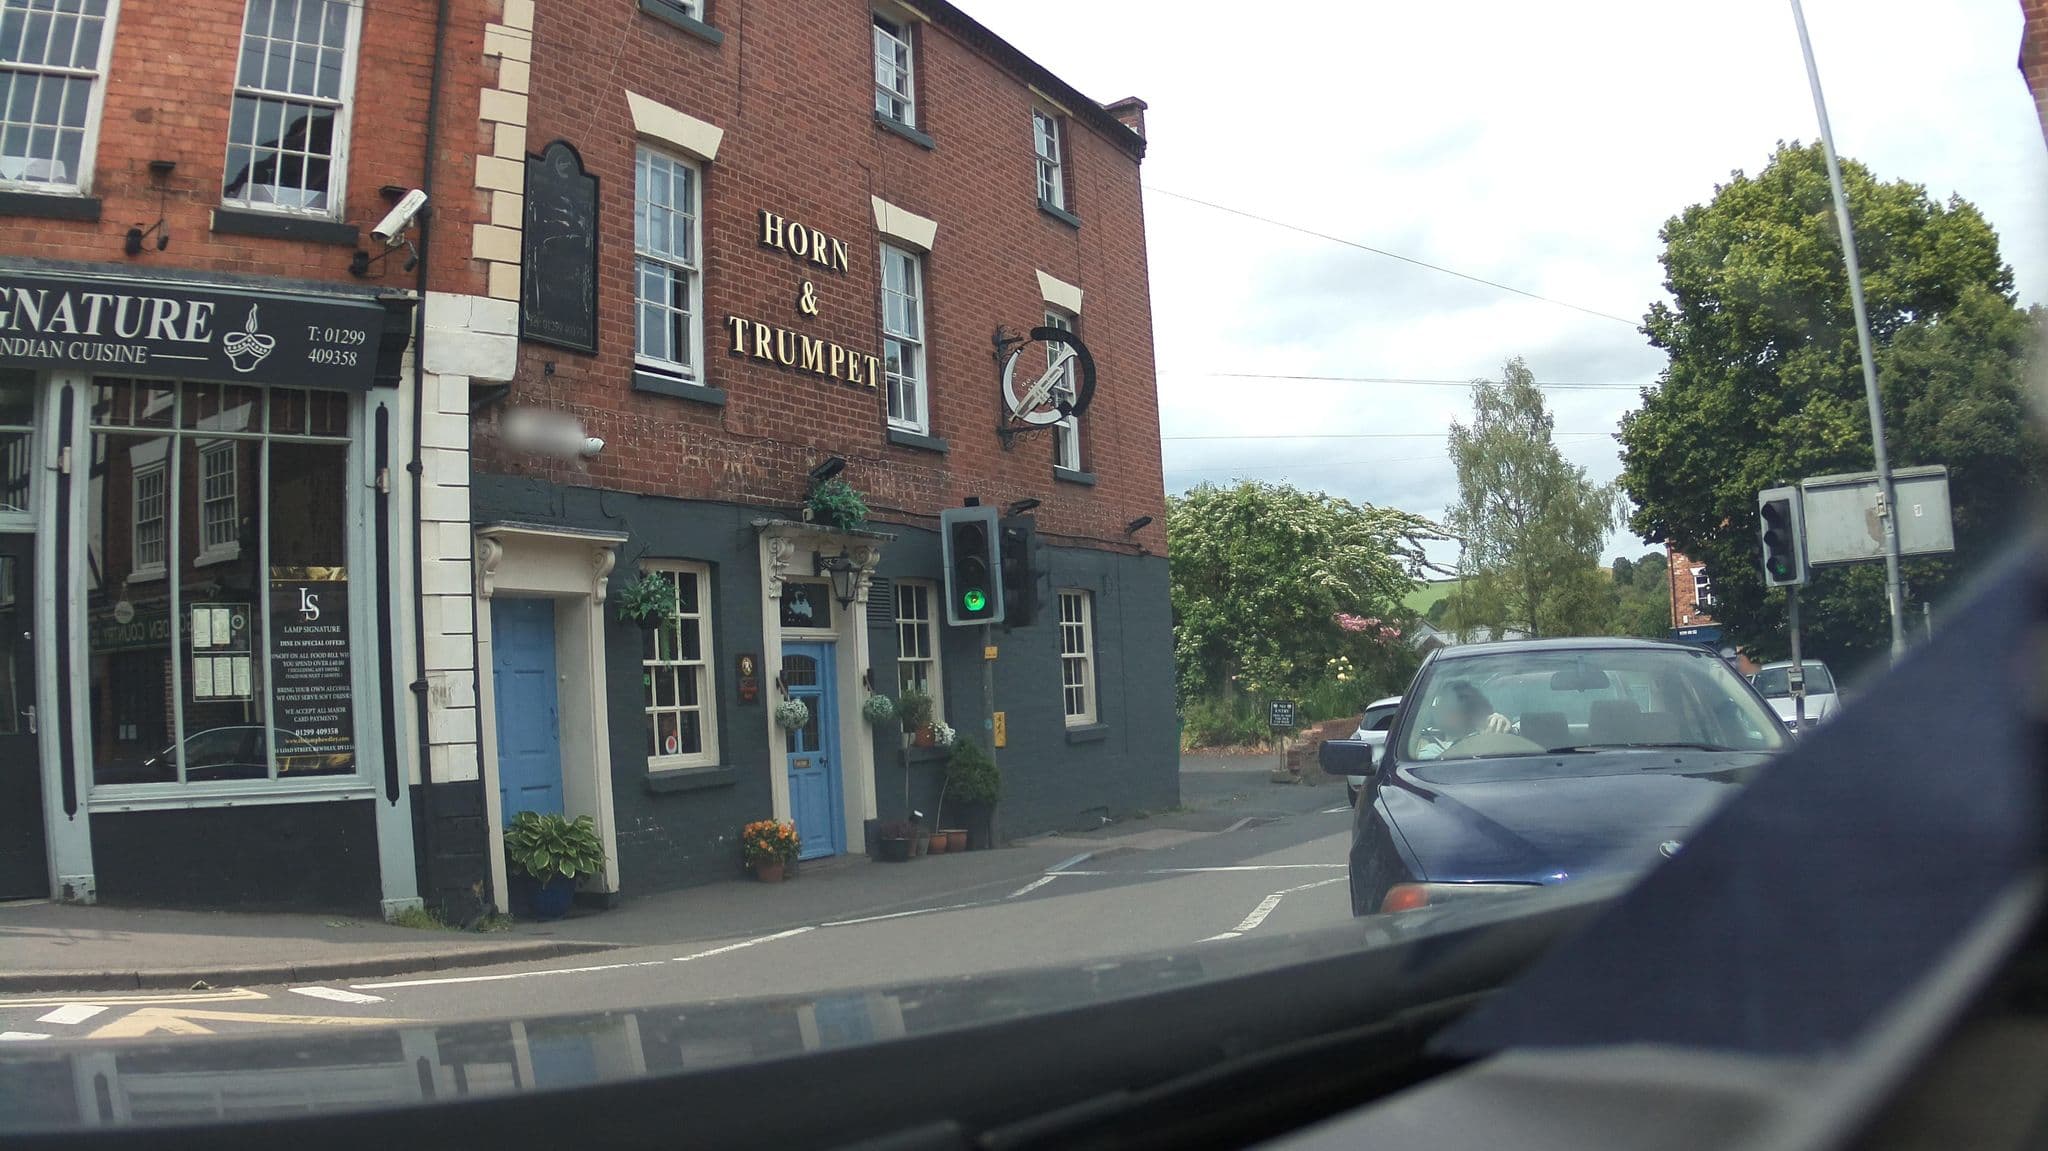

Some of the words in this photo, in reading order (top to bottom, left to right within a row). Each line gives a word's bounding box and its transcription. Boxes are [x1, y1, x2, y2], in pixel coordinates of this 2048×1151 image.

[762, 210, 849, 272] HORN
[800, 281, 819, 316] &
[307, 326, 320, 342] T:
[324, 328, 366, 346] 01299
[68, 341, 148, 364] CUISINE
[308, 348, 358, 367] 409358
[729, 316, 880, 387] TRUMPET
[303, 625, 341, 633] SIGNATURE
